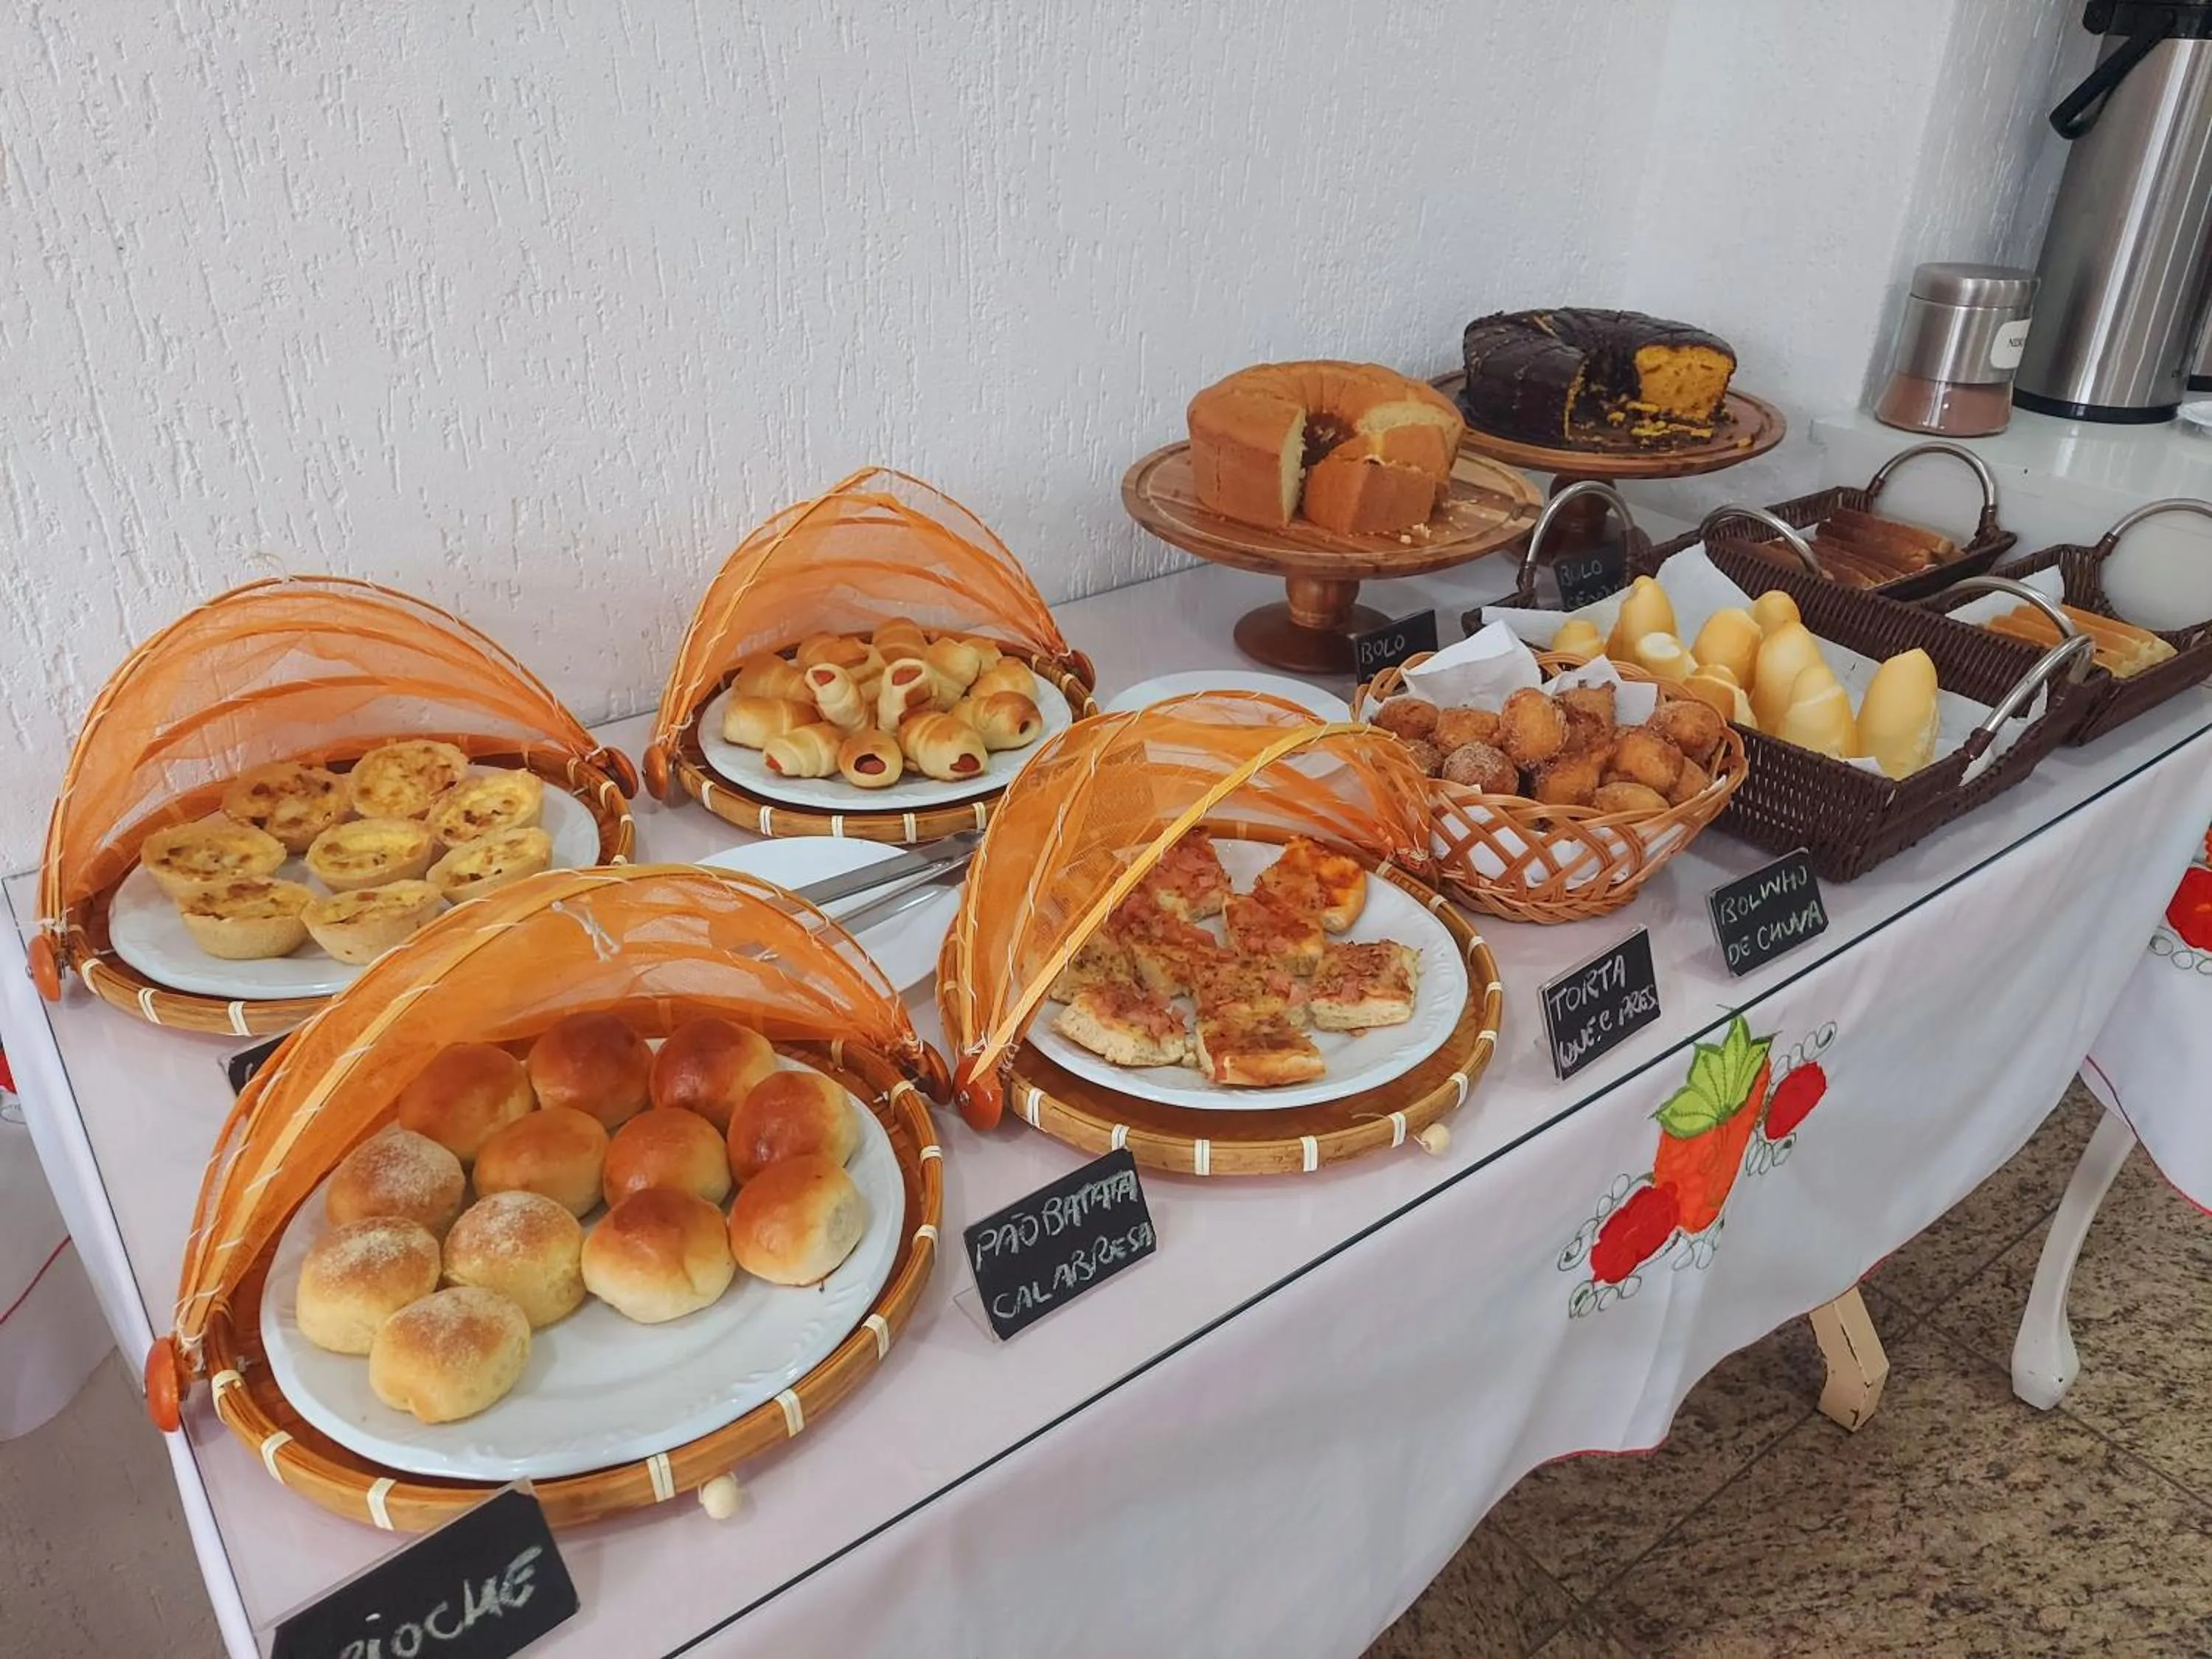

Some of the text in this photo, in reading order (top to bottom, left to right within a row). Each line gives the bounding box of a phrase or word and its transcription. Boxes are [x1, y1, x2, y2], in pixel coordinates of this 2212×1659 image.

[1559, 559, 1603, 587] BOLO
[1360, 634, 1405, 664] BOLO
[1719, 865, 1807, 926] BOLINHO
[1728, 899, 1823, 966] DE CHUVA
[1549, 954, 1627, 1022] TORTA
[975, 1169, 1138, 1273] PÃO BATATA
[992, 1221, 1155, 1319] CALABRESA
